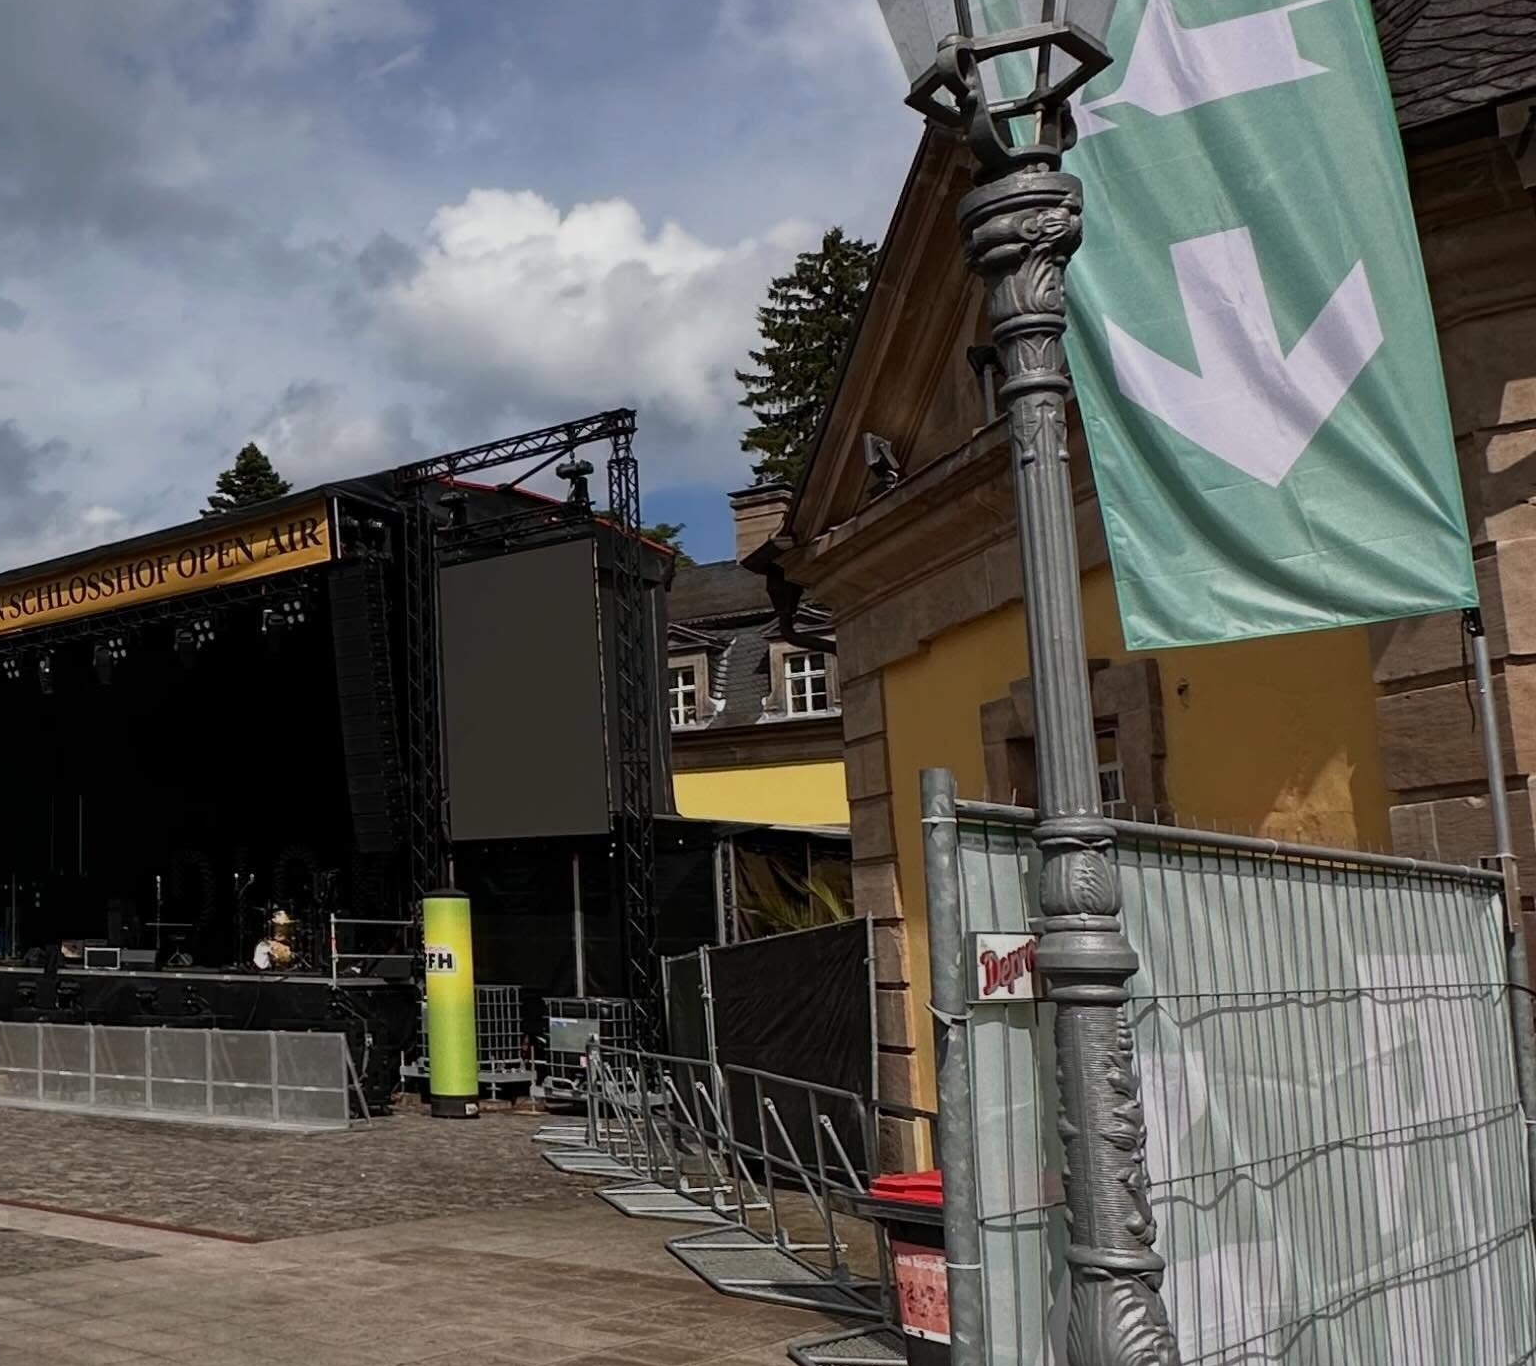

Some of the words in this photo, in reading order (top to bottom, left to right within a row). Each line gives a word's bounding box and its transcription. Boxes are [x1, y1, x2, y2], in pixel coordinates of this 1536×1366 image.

[9, 554, 172, 619] SCHLOSSHOF
[176, 532, 257, 579] OPEN
[264, 517, 324, 559] AIR
